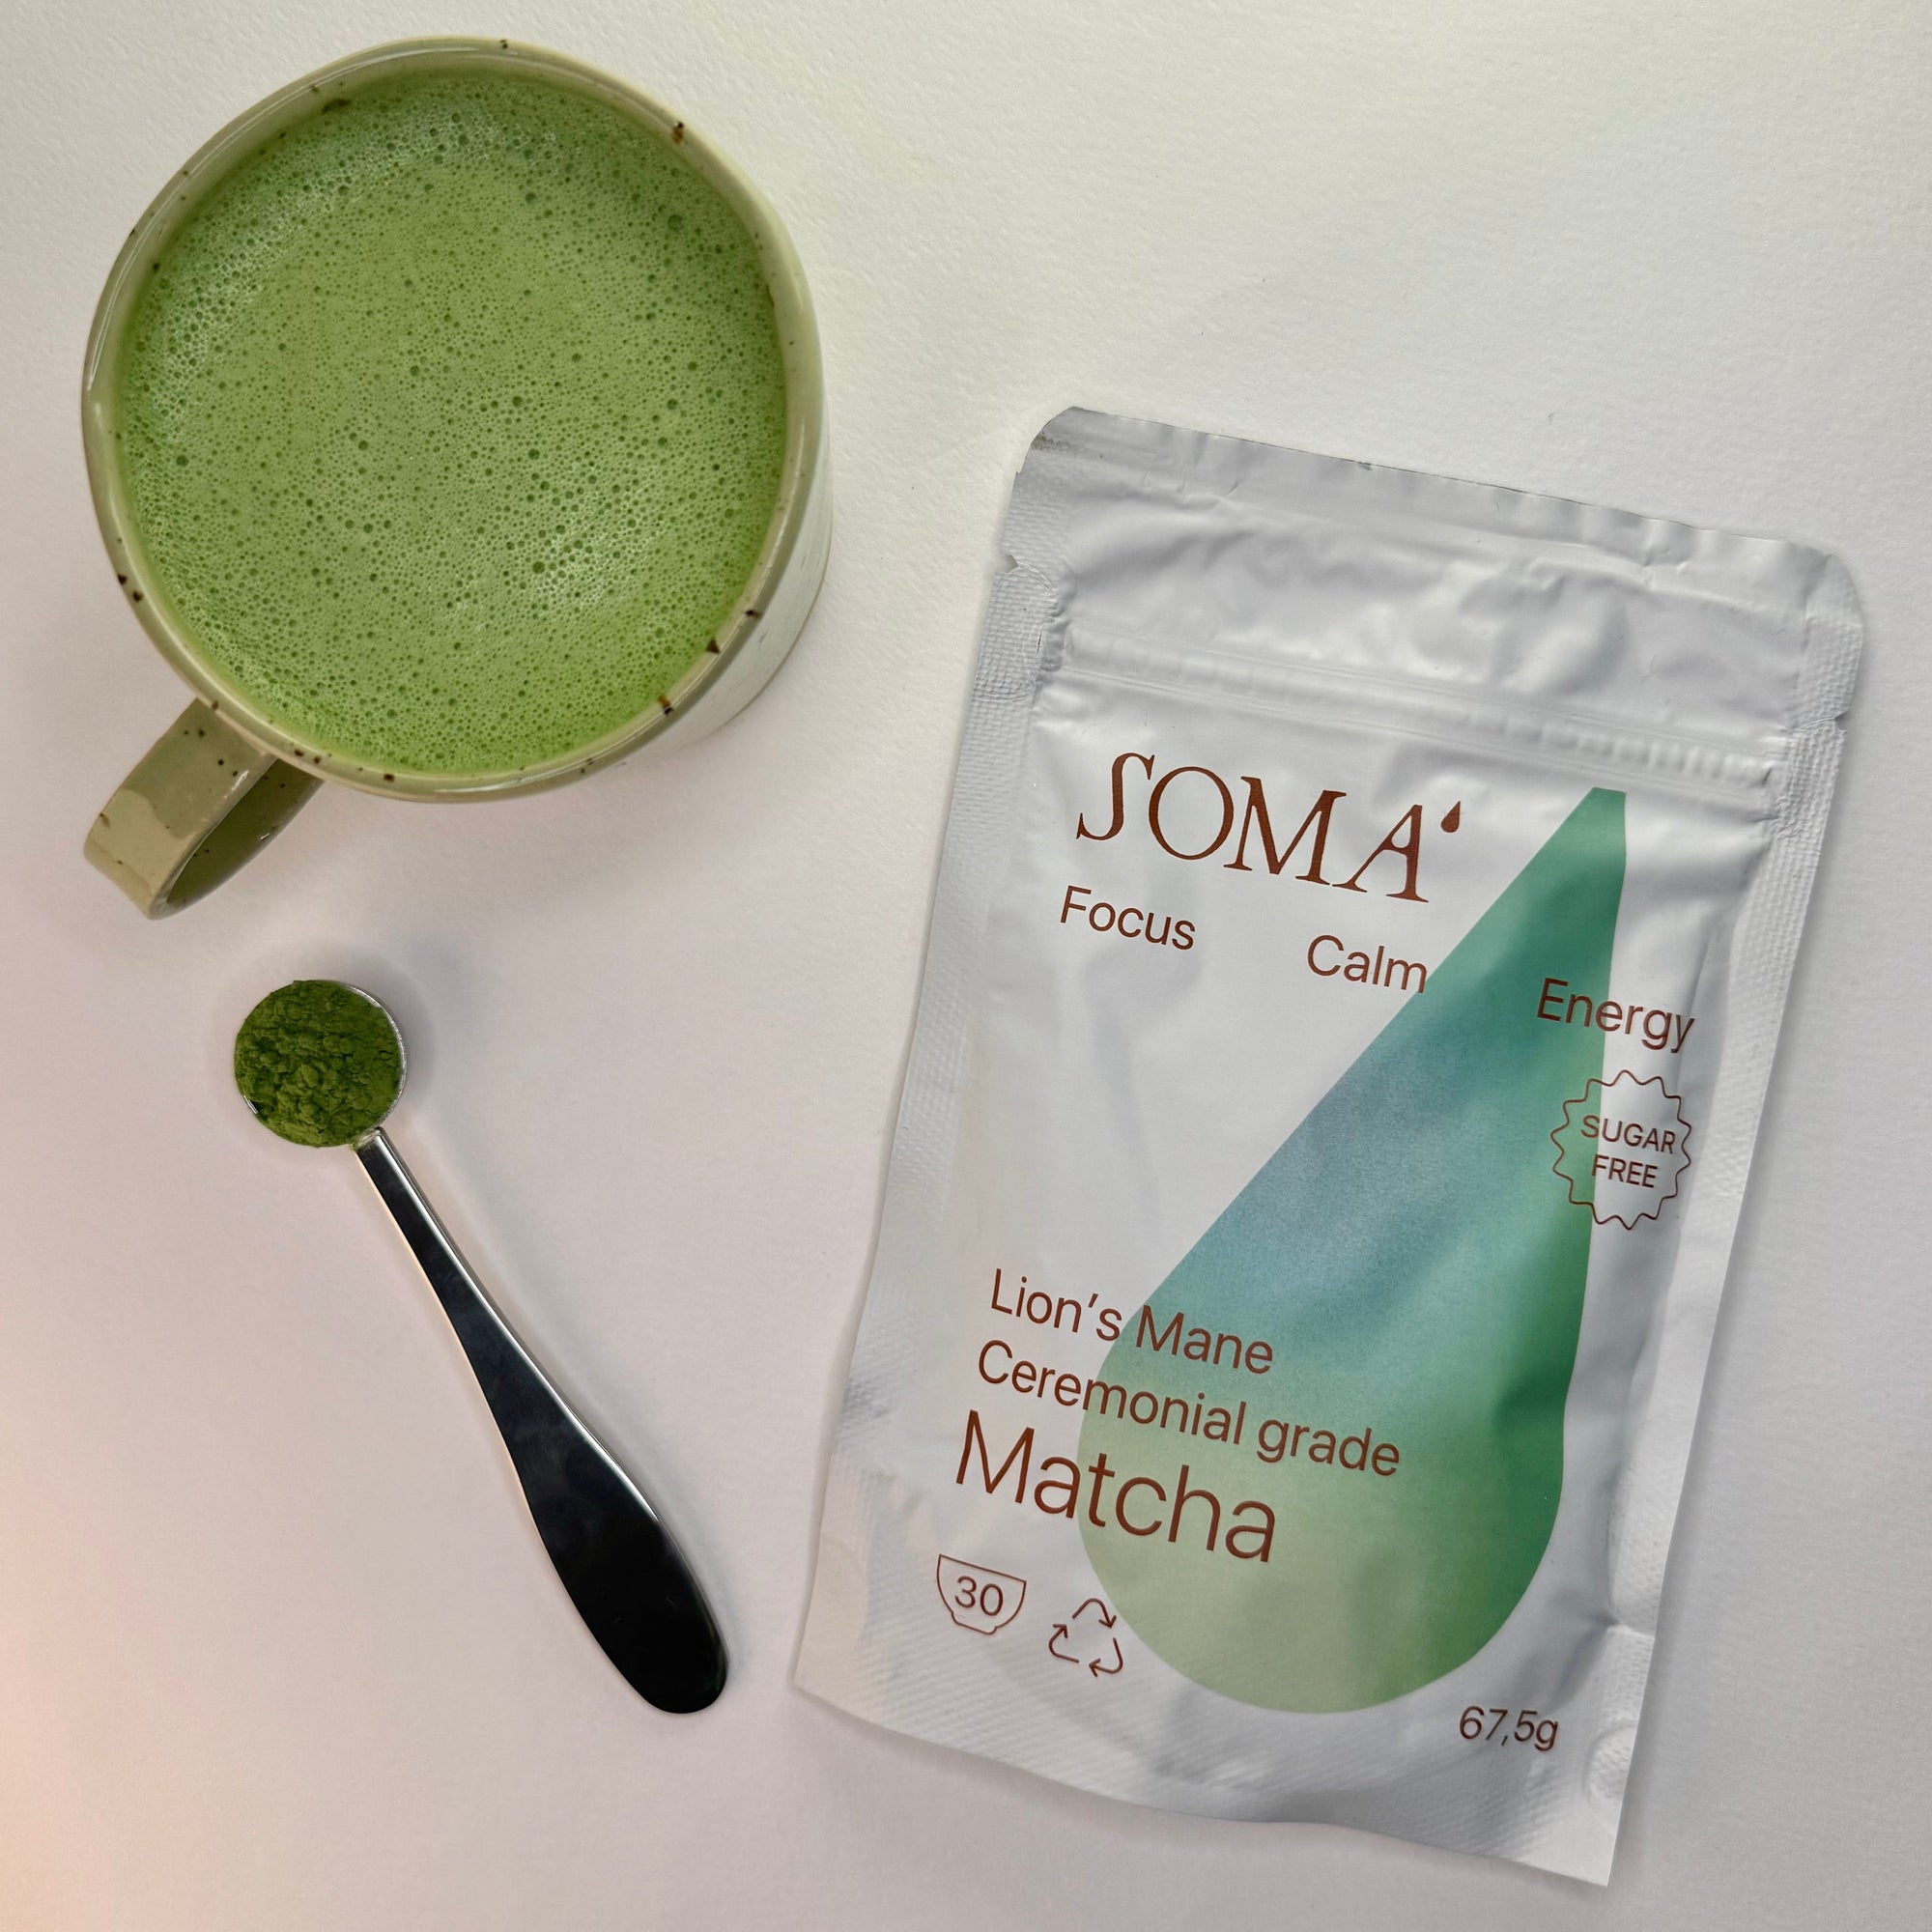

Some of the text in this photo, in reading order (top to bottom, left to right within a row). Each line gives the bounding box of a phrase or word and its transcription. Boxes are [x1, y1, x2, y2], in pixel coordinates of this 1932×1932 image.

[1075, 752, 1429, 904] SOMA
[1059, 884, 1695, 1054] Focus Calm Energy
[1580, 1114, 1676, 1154] SUGAR
[1590, 1154, 1659, 1189] FREE
[1135, 1304, 1274, 1376] Mane
[977, 1338, 1401, 1477] Ceremonial grade
[955, 1408, 1277, 1563] Matcha
[952, 1576, 1005, 1618] 30
[1458, 1705, 1558, 1751] 67,5g
